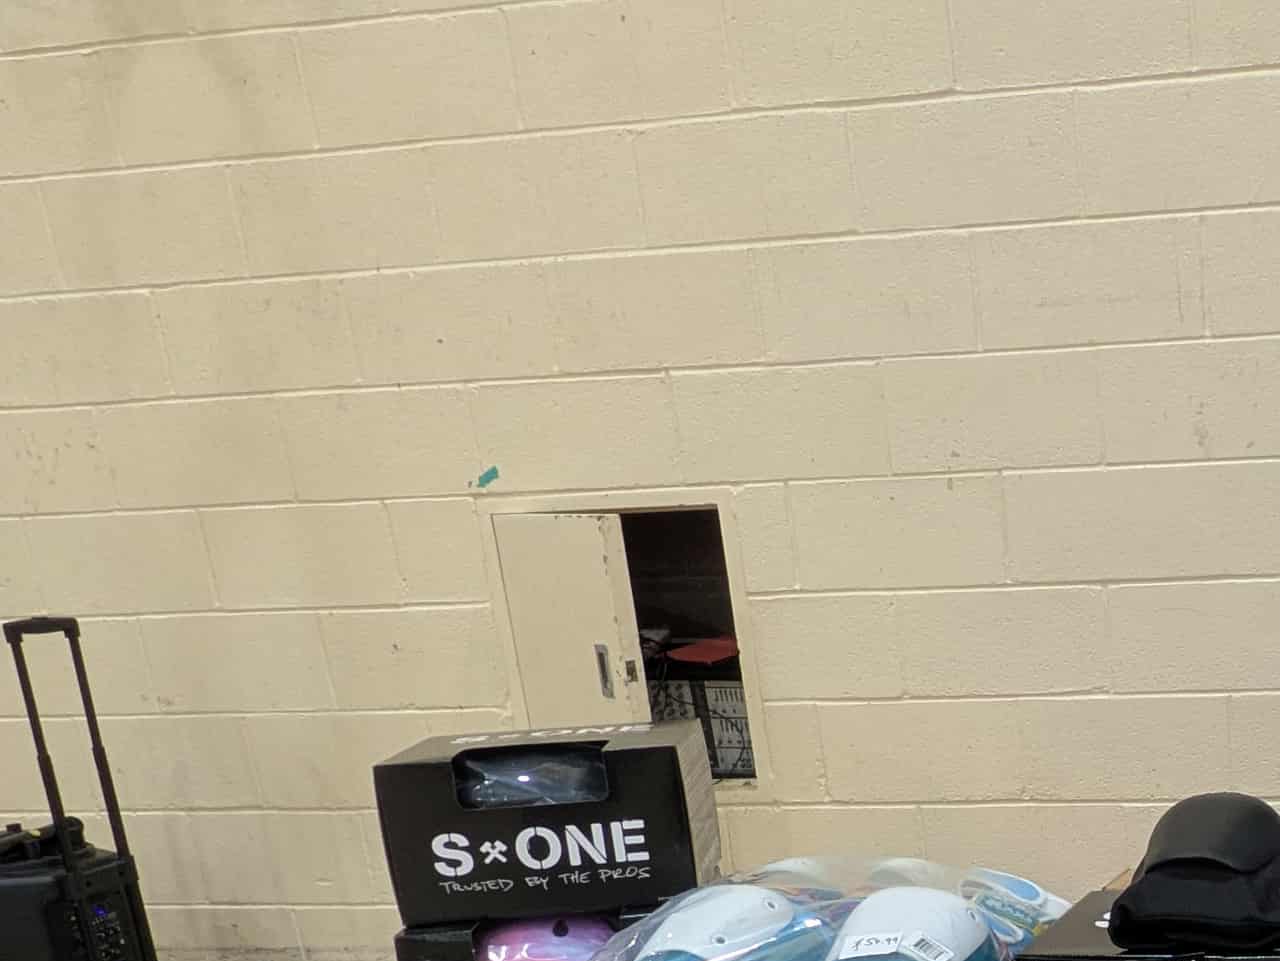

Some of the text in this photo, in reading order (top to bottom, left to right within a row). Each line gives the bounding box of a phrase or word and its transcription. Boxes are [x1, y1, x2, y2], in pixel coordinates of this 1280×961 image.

[438, 866, 652, 895] TRUSTED BY THE PROS
